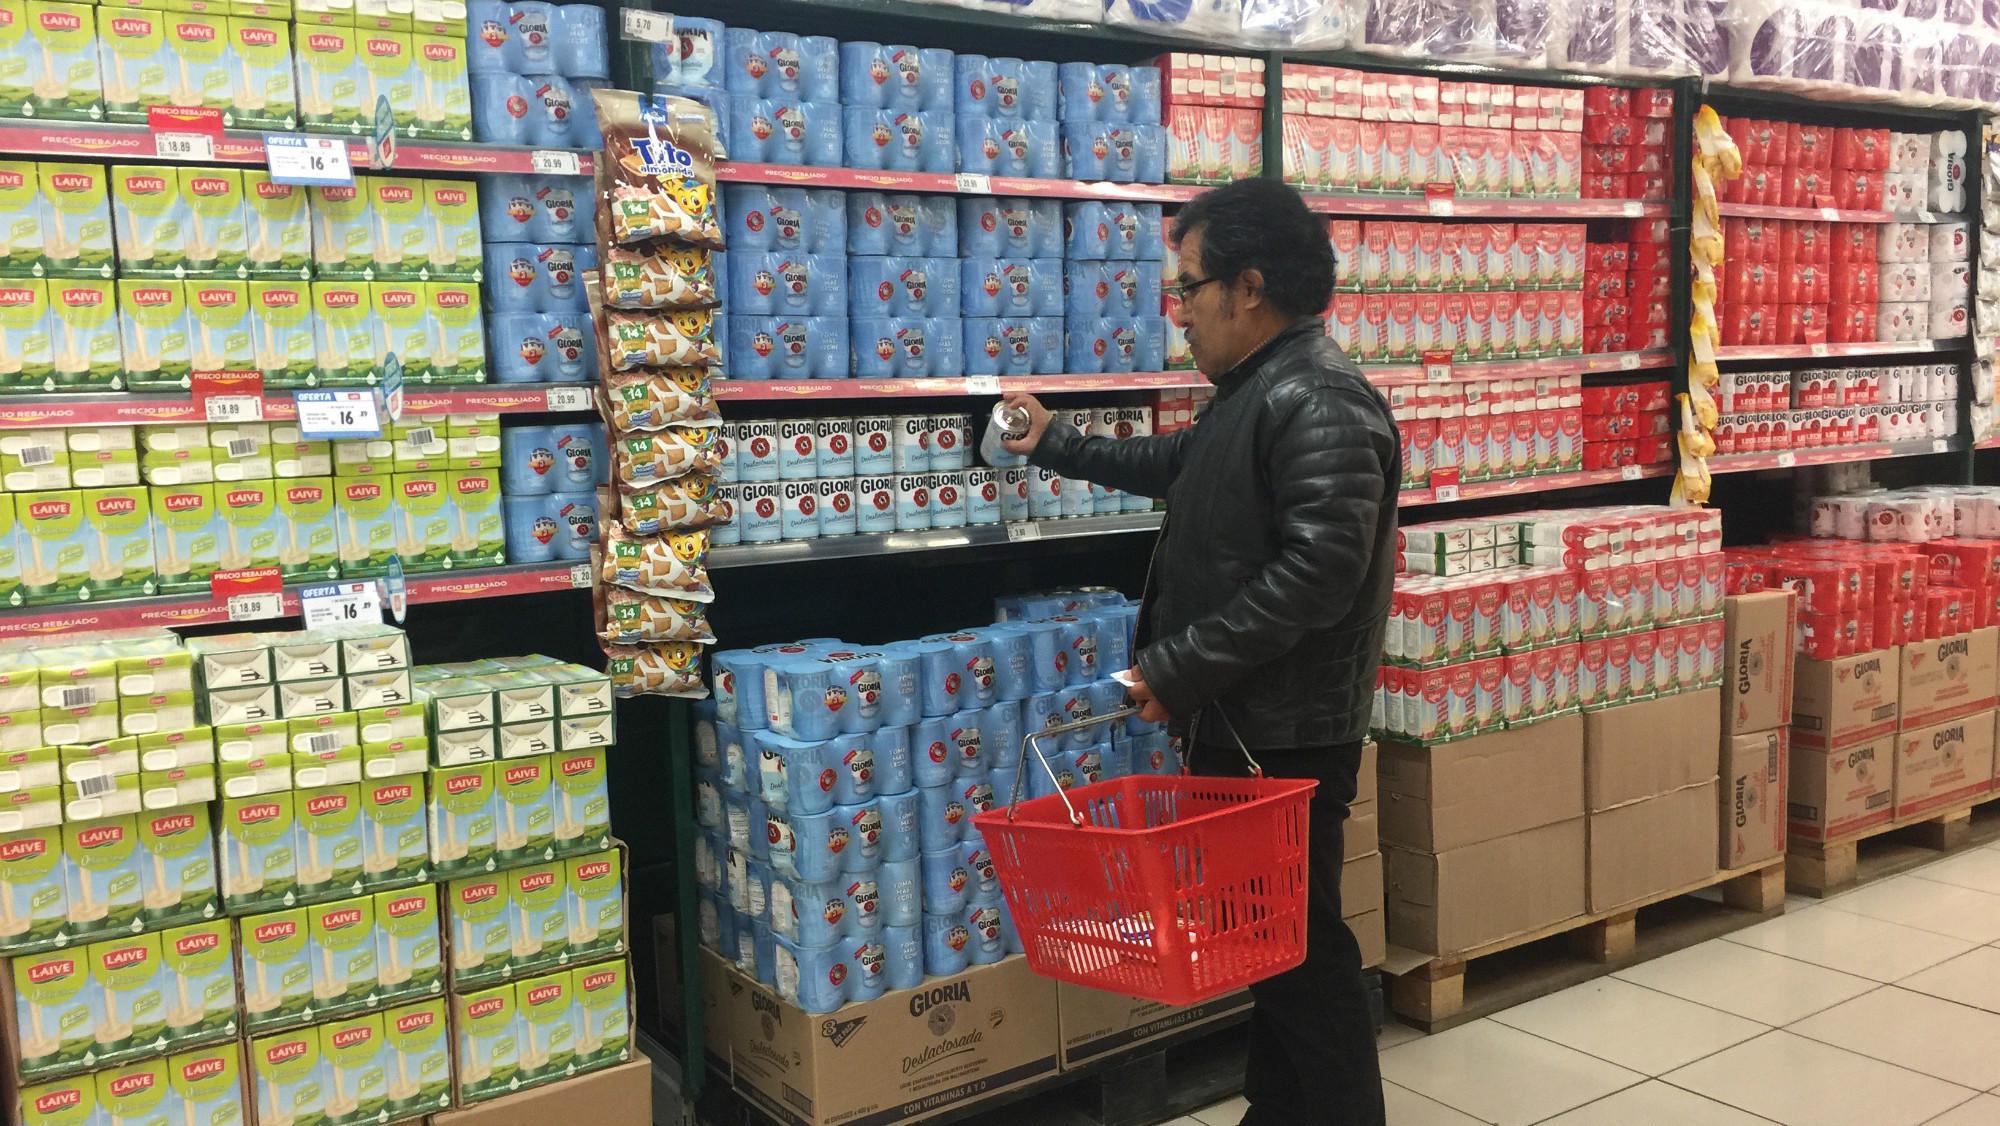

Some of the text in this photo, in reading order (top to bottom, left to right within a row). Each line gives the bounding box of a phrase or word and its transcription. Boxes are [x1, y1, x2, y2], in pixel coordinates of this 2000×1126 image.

[43, 15, 79, 27] LAIVE
[114, 20, 149, 32] LAIVE
[637, 18, 651, 30] 5.70
[179, 26, 212, 37] LAIVE
[519, 23, 547, 33] GLORIA
[243, 31, 275, 42] LAIVE
[311, 36, 341, 48] LAIVE
[370, 41, 398, 52] LAIVE
[426, 46, 454, 57] LAIVE
[545, 98, 570, 109] GLORIA
[151, 107, 219, 117] PRECIO REBAJADO
[41, 136, 140, 147] PRECIO REBAJADO
[168, 142, 191, 151] 18.89
[268, 137, 302, 146] OFERTA
[310, 157, 324, 170] 16
[453, 155, 497, 163] REBAJADO
[543, 159, 561, 169] 20.99
[1947, 152, 1956, 191] GLORIA
[55, 176, 90, 187] LAIVE
[129, 179, 162, 189] LAIVE
[194, 180, 227, 191] LAIVE
[259, 183, 289, 194] LAIVE
[324, 187, 354, 197] LAIVE
[382, 188, 411, 198] LAIVE
[436, 191, 465, 201] LAIVE
[546, 200, 573, 209] GLORIA
[548, 262, 573, 272] GLORIA
[620, 267, 635, 277] 14
[65, 291, 100, 302] LAIVE
[135, 291, 169, 302] LAIVE
[201, 292, 234, 302] LAIVE
[265, 292, 296, 303] LAIVE
[326, 293, 357, 303] LAIVE
[385, 293, 413, 303] LAIVE
[439, 294, 467, 303] LAIVE
[625, 328, 639, 338] 14
[783, 334, 806, 344] GLORIA
[557, 338, 583, 348] GLORIA
[194, 371, 260, 380] PRECIO REBAJADO
[298, 392, 331, 401] OFERTA
[557, 394, 575, 404] 20.99
[628, 389, 642, 399] 14
[17, 408, 75, 417] REBAJADO
[217, 404, 239, 414] 18.89
[340, 411, 354, 424] 16
[927, 417, 963, 432] GLORIA
[738, 424, 777, 441] GLORIA
[633, 441, 647, 452] 14
[459, 479, 488, 490] LAIVE
[928, 474, 964, 490] GLORIA
[289, 488, 321, 500] LAIVE
[348, 486, 379, 497] LAIVE
[406, 483, 435, 494] LAIVE
[167, 497, 200, 508] LAIVE
[229, 493, 261, 504] LAIVE
[637, 497, 652, 508] 14
[32, 503, 67, 515] LAIVE
[99, 500, 133, 512] LAIVE
[621, 546, 635, 556] 14
[214, 569, 278, 580] PRECIO REBAJADO
[303, 587, 336, 597] OFERTA
[431, 581, 507, 593] PRECIO REBAJADO
[239, 602, 261, 612] 18.89
[344, 604, 357, 618] 16
[621, 608, 635, 618] 14
[141, 610, 179, 619] PRECIO
[0, 617, 99, 632] PRECIO REBAJADO
[1938, 638, 1968, 662] GLORIA
[614, 662, 628, 672] 14
[975, 667, 996, 677] GLORIA
[1739, 638, 1753, 695] GLORIA
[1854, 658, 1881, 679] GLORIA
[858, 682, 881, 693] GLORIA
[958, 737, 981, 747] GLORIA
[1933, 726, 1964, 750] GLORIA
[1848, 747, 1875, 768] GLORIA
[564, 759, 593, 771] LAIVE
[851, 759, 874, 772] GLORIA
[507, 768, 537, 780] LAIVE
[449, 778, 479, 790] LAIVE
[377, 787, 409, 799] LAIVE
[310, 798, 344, 810] LAIVE
[1736, 775, 1747, 828] GLORIA
[241, 807, 277, 819] LAIVE
[154, 816, 191, 831] LAIVE
[860, 820, 882, 833] GLORIA
[81, 828, 120, 843] LAIVE
[3, 841, 42, 855] LAIVE
[580, 865, 608, 876] LAIVE
[522, 876, 552, 888] LAIVE
[464, 887, 495, 899] LAIVE
[855, 890, 879, 904] GLORIA
[391, 900, 423, 913] LAIVE
[324, 912, 358, 926] LAIVE
[978, 918, 1000, 930] GLORIA
[258, 924, 292, 938] LAIVE
[179, 935, 215, 949] LAIVE
[107, 950, 144, 965] LAIVE
[862, 953, 885, 966] GLORIA
[31, 963, 71, 979] LAIVE
[585, 974, 613, 986] LAIVE
[530, 988, 559, 1000] LAIVE
[910, 979, 971, 1017] GLORIA
[471, 1001, 501, 1014] LAIVE
[752, 991, 782, 1028] GLORIA
[400, 1015, 431, 1029] LAIVE
[821, 1019, 838, 1038] 8
[335, 1030, 369, 1043] LAIVE
[269, 1044, 304, 1059] LAIVE
[902, 1028, 984, 1074] Deslactosada
[186, 1061, 221, 1076] LAIVE
[114, 1076, 151, 1091] LAIVE
[39, 1092, 77, 1108] LAIVE
[904, 1080, 986, 1115] CON VITAMINAS A Y D
